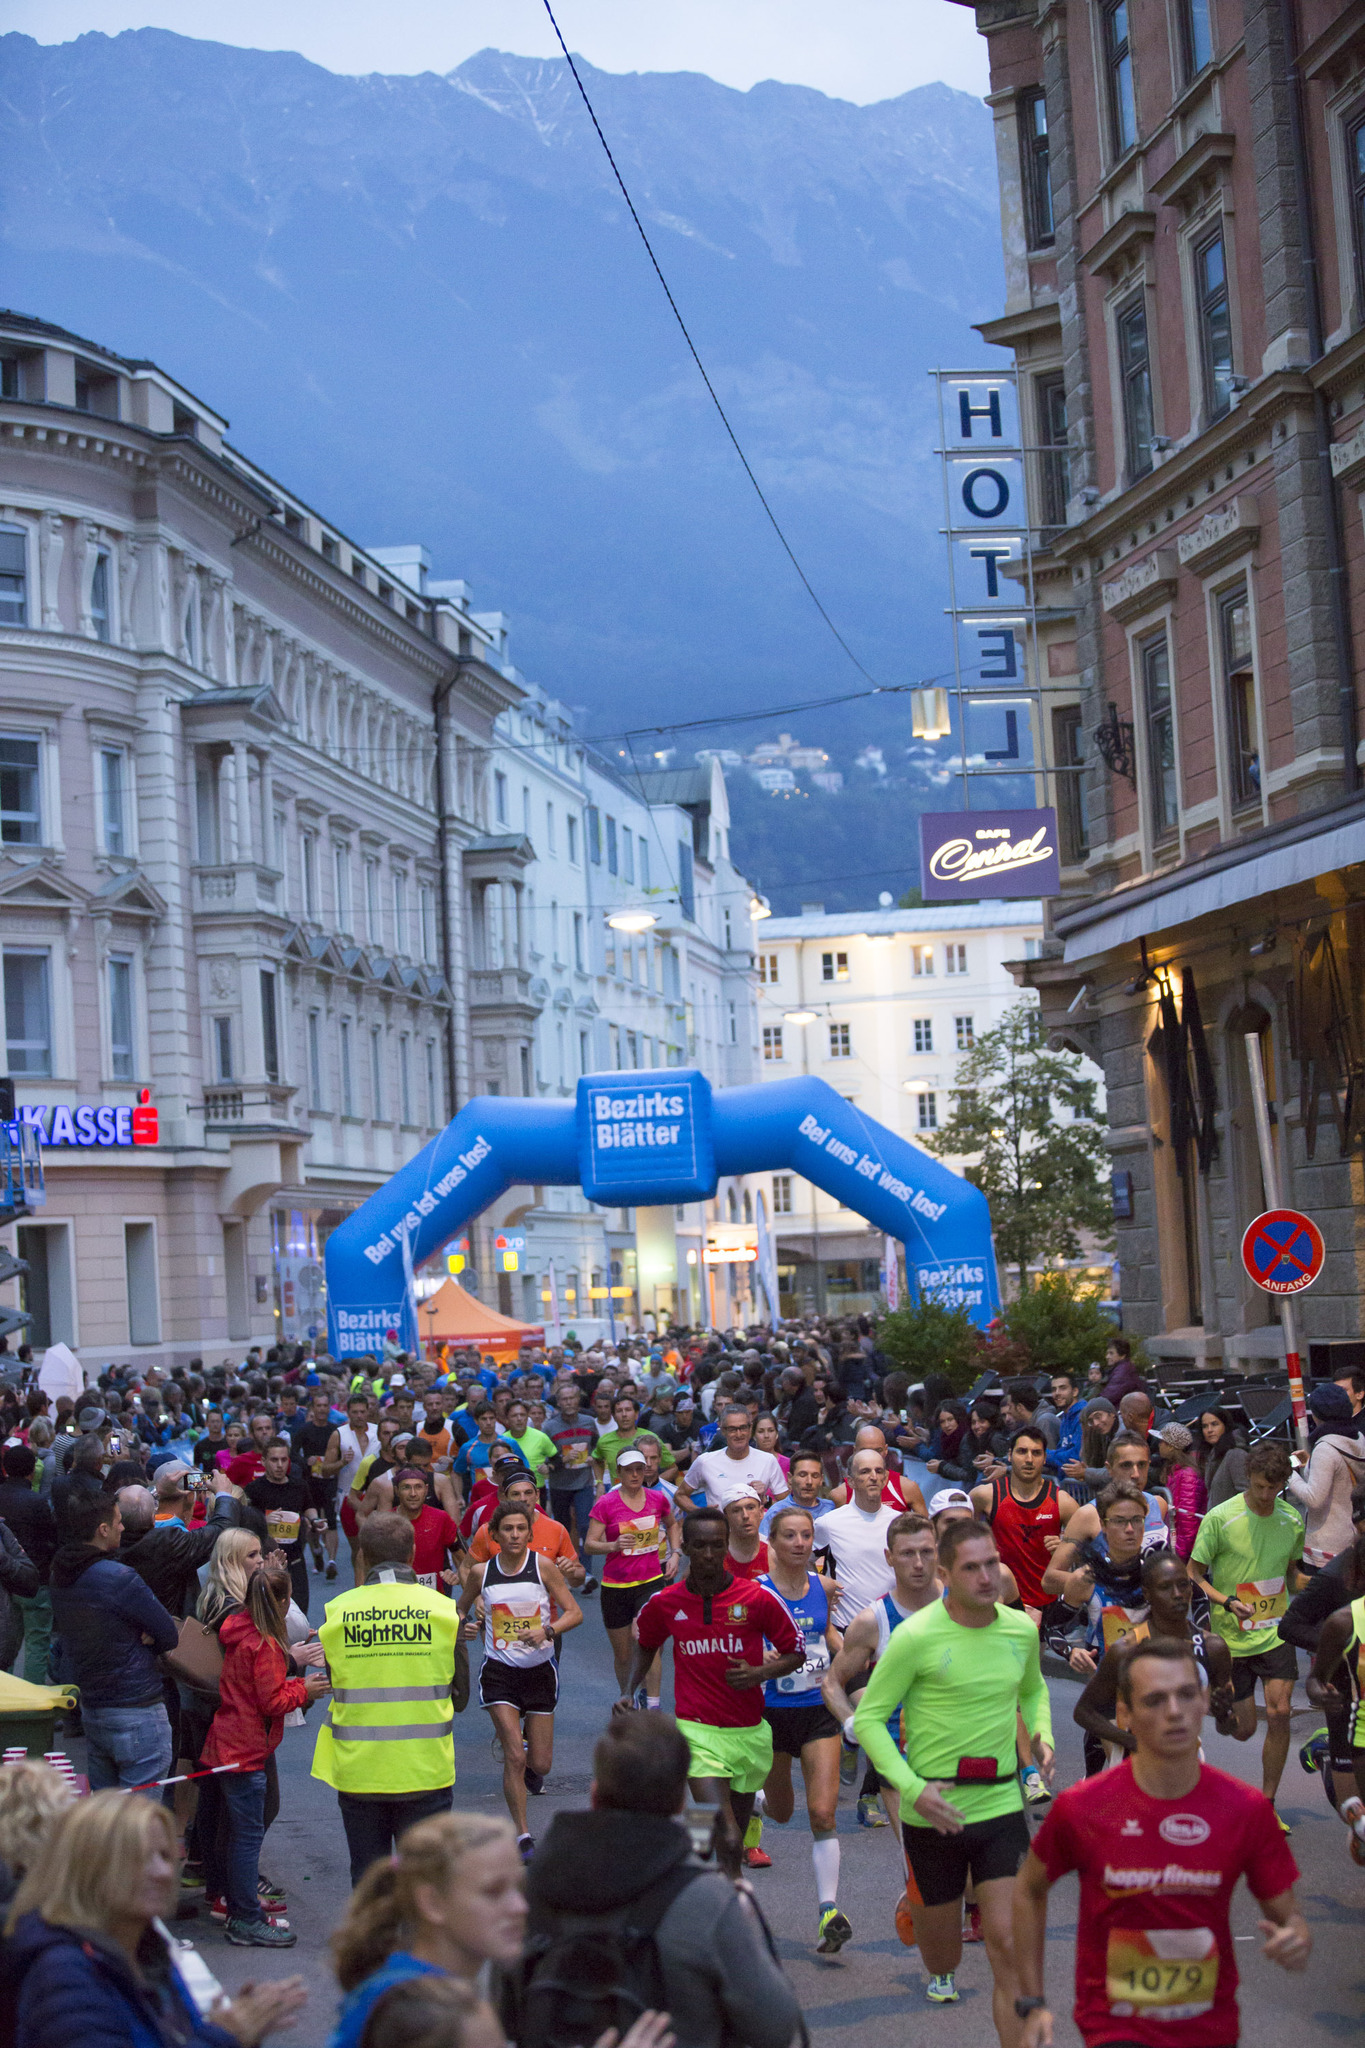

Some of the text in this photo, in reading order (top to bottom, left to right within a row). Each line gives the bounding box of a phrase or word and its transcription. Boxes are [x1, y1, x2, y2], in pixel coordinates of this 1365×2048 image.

[975, 828, 1011, 839] CAFE
[595, 1091, 684, 1120] Bezirks
[596, 1121, 680, 1149] Blätter
[798, 1113, 948, 1222] Bei uns ist was los!
[363, 1232, 396, 1265] Bei
[412, 1190, 440, 1216] ist
[433, 1165, 467, 1197] was
[458, 1134, 492, 1170] los!
[918, 1263, 984, 1288] Bezirks
[1261, 1273, 1312, 1291] ANFANG
[337, 1309, 402, 1329] Bezirks
[340, 1331, 387, 1351] Blätt
[342, 1605, 432, 1622] Innsbrucker
[344, 1623, 432, 1648] NightRUN
[503, 1620, 531, 1634] 258
[679, 1633, 744, 1655] SOMALIA
[1122, 1965, 1203, 1993] 1079
